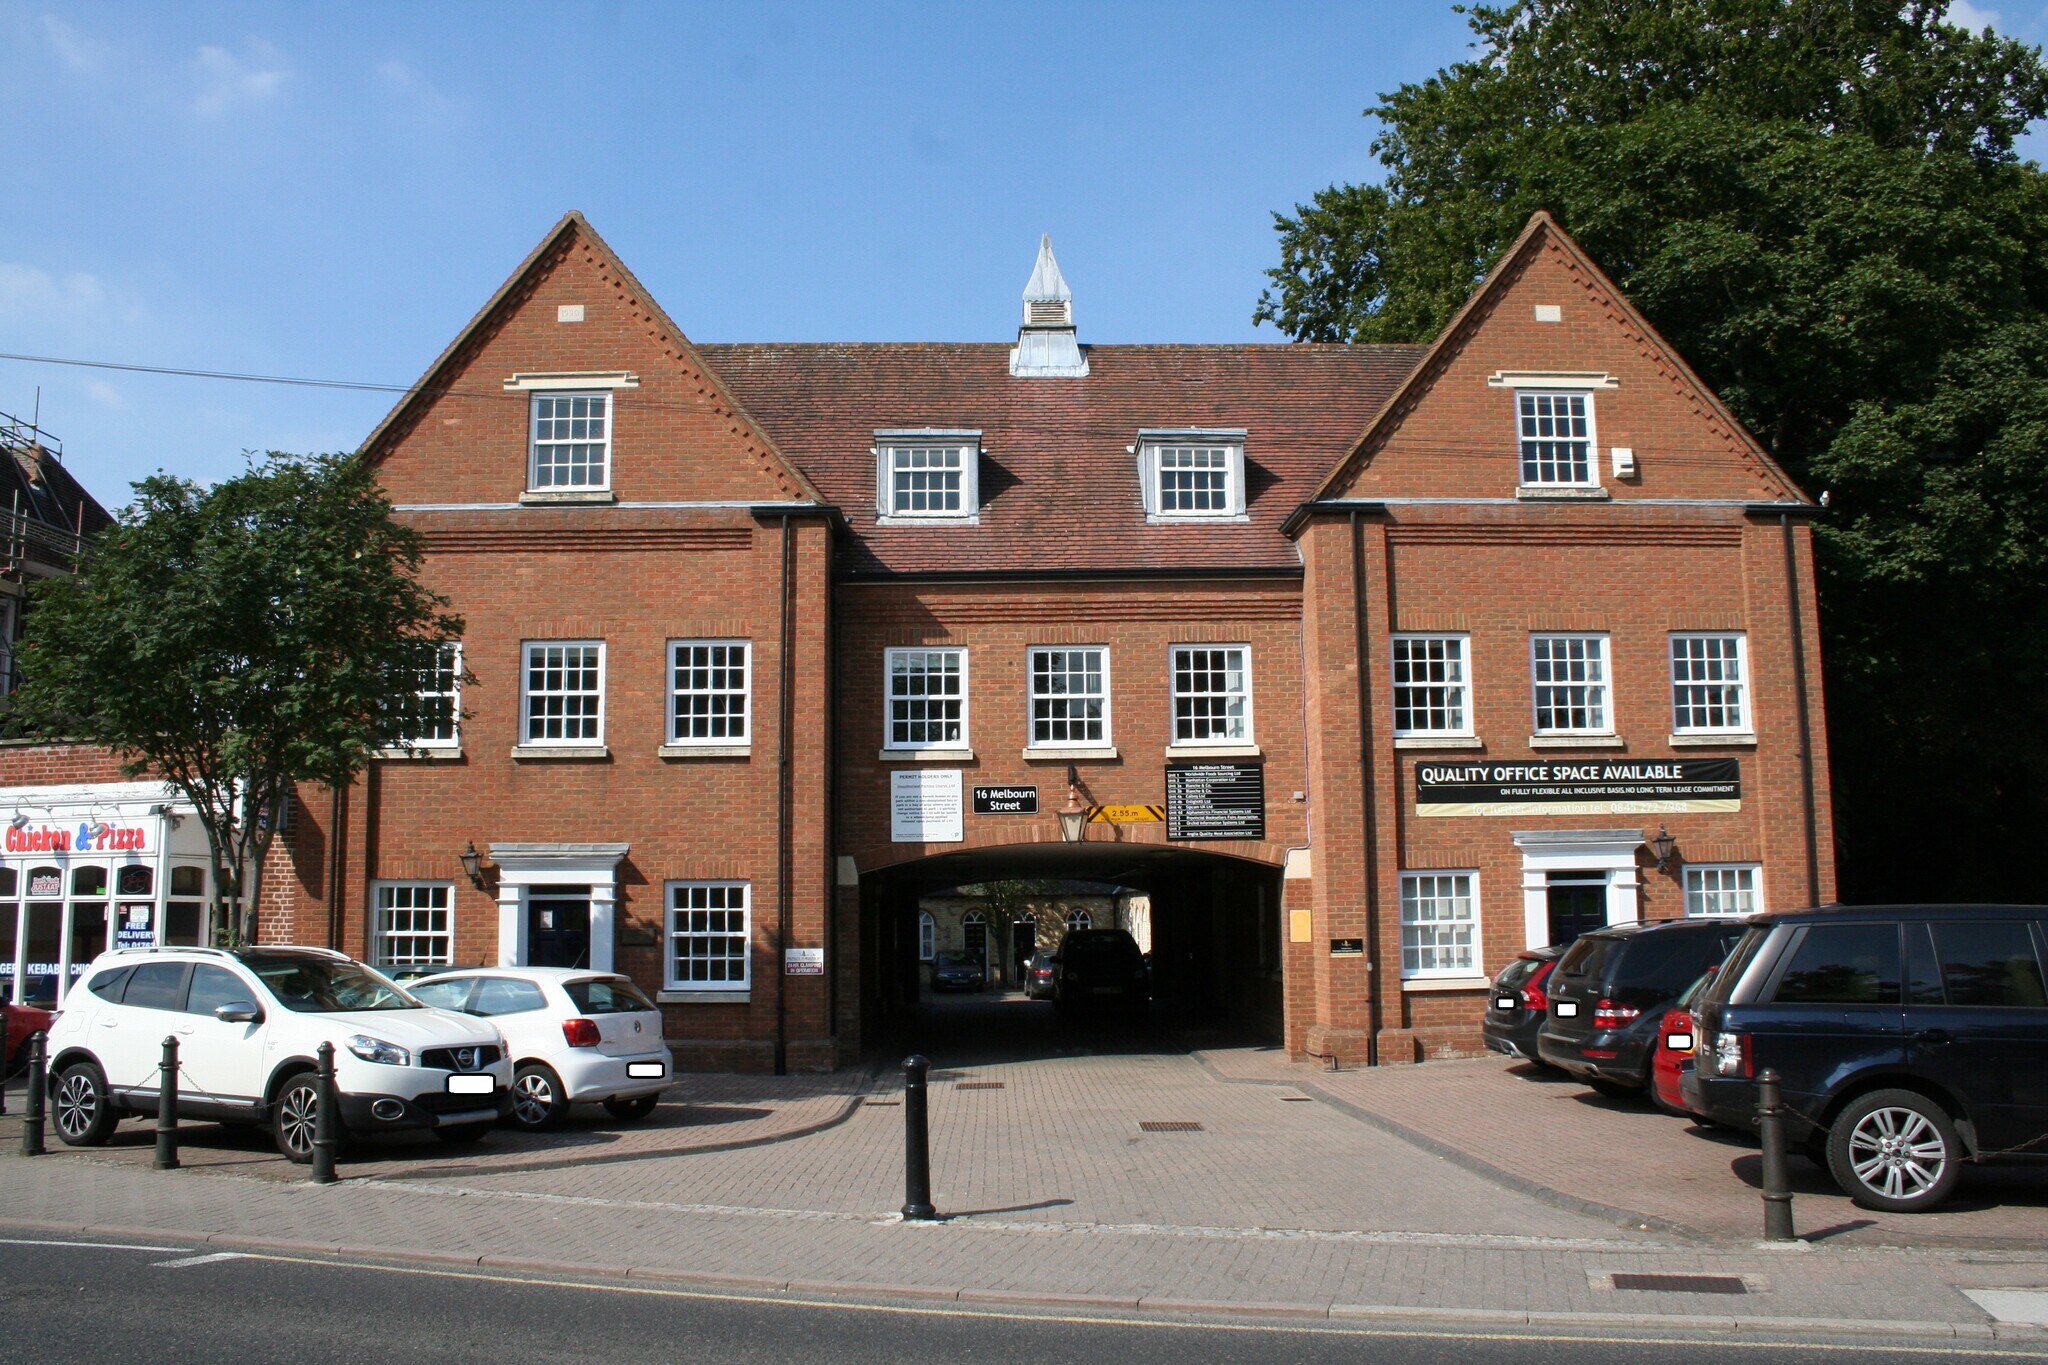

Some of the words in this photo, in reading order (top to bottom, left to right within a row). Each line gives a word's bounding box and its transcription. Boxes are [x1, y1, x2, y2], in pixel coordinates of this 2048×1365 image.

[1422, 768, 1489, 784] QUALITY
[1493, 767, 1549, 781] OFFICE
[1553, 766, 1599, 780] SPACE
[1603, 765, 1683, 780] AVAILABLE
[976, 790, 987, 799] 16
[990, 789, 1035, 798] Melbourn
[990, 801, 1020, 810] Street
[1472, 805, 1486, 814] for
[1490, 804, 1523, 814] further
[1529, 803, 1586, 813] information
[1590, 802, 1607, 812] tel:
[1611, 803, 1636, 812] 0845
[6, 824, 72, 852] Chicken
[76, 822, 92, 851] &
[96, 822, 145, 851] Pizza
[125, 922, 146, 930] FREE
[27, 963, 60, 974] KEBAB
